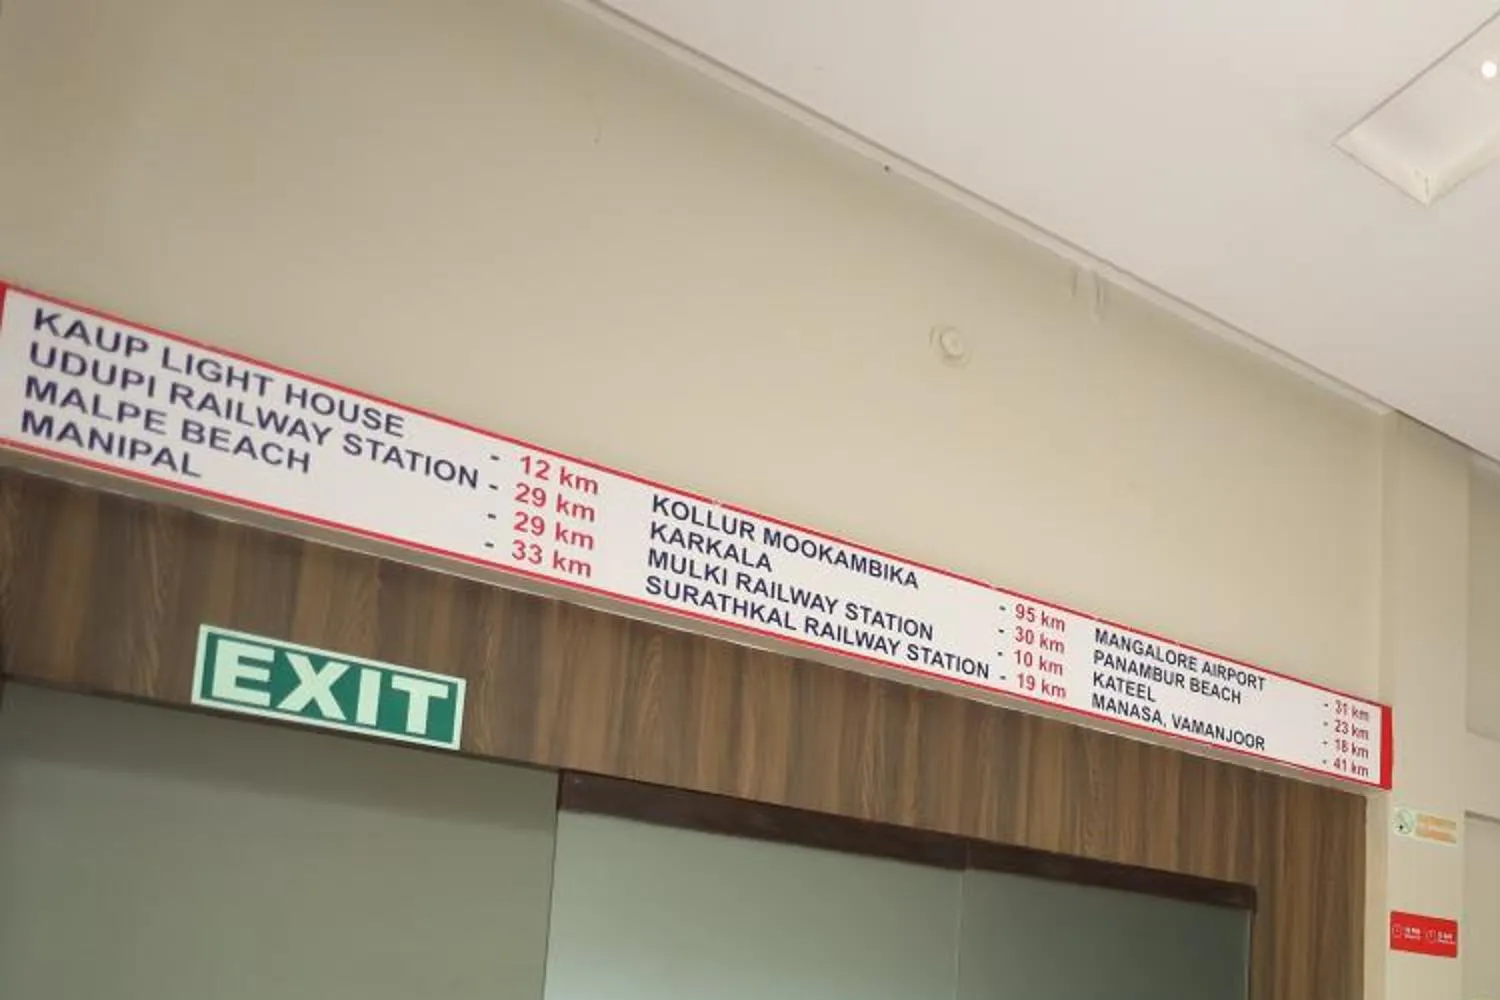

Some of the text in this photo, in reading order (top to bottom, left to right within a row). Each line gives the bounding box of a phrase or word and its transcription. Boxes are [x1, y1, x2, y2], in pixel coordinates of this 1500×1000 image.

[24, 375, 167, 435] MALPE
[181, 418, 310, 474] BEACH
[513, 511, 545, 537] 29
[555, 521, 594, 550] km
[30, 341, 156, 398] UDUPI
[169, 381, 333, 446] RAILWAY
[342, 432, 479, 489] STATION
[514, 482, 547, 508] 29
[556, 493, 595, 522] km
[34, 308, 149, 358] KAUP
[162, 346, 274, 397] LIGHT
[286, 384, 404, 438] HOUSE
[521, 455, 551, 481] 12
[559, 466, 599, 495] km
[21, 409, 201, 478] MANIPAL
[511, 539, 543, 565] 33
[552, 550, 592, 578] km
[647, 547, 727, 596] MULKI
[736, 571, 838, 624] RAILWAY
[845, 602, 933, 651] STATION
[1014, 649, 1033, 667] 10
[1039, 655, 1063, 676] km
[650, 521, 773, 573] KARKALA
[1015, 625, 1035, 645] 30
[1040, 632, 1065, 655] km
[653, 493, 755, 542] KOLLUR
[763, 527, 919, 589] MOOKAMBIKA
[1015, 603, 1035, 623] 95
[1041, 610, 1065, 633] km
[211, 639, 449, 735] EXIT
[645, 575, 797, 641] SURATHKAL
[804, 615, 901, 663] RAILWAY
[907, 643, 990, 690] STATION
[1017, 672, 1036, 691] 19
[1041, 679, 1066, 698] km
[1093, 649, 1185, 690] PANAMBUR
[1189, 677, 1242, 705] BEACH
[1334, 719, 1349, 735] 23
[1351, 723, 1369, 741] km
[1095, 628, 1198, 673] MANGALORE
[1201, 660, 1267, 691] AIRPORT
[1351, 706, 1369, 722] km
[1093, 671, 1156, 703] KATEEL
[1351, 742, 1369, 760] km
[1171, 713, 1265, 751] VAMANJOOR
[1333, 757, 1347, 772] 41
[1351, 761, 1369, 778] km
